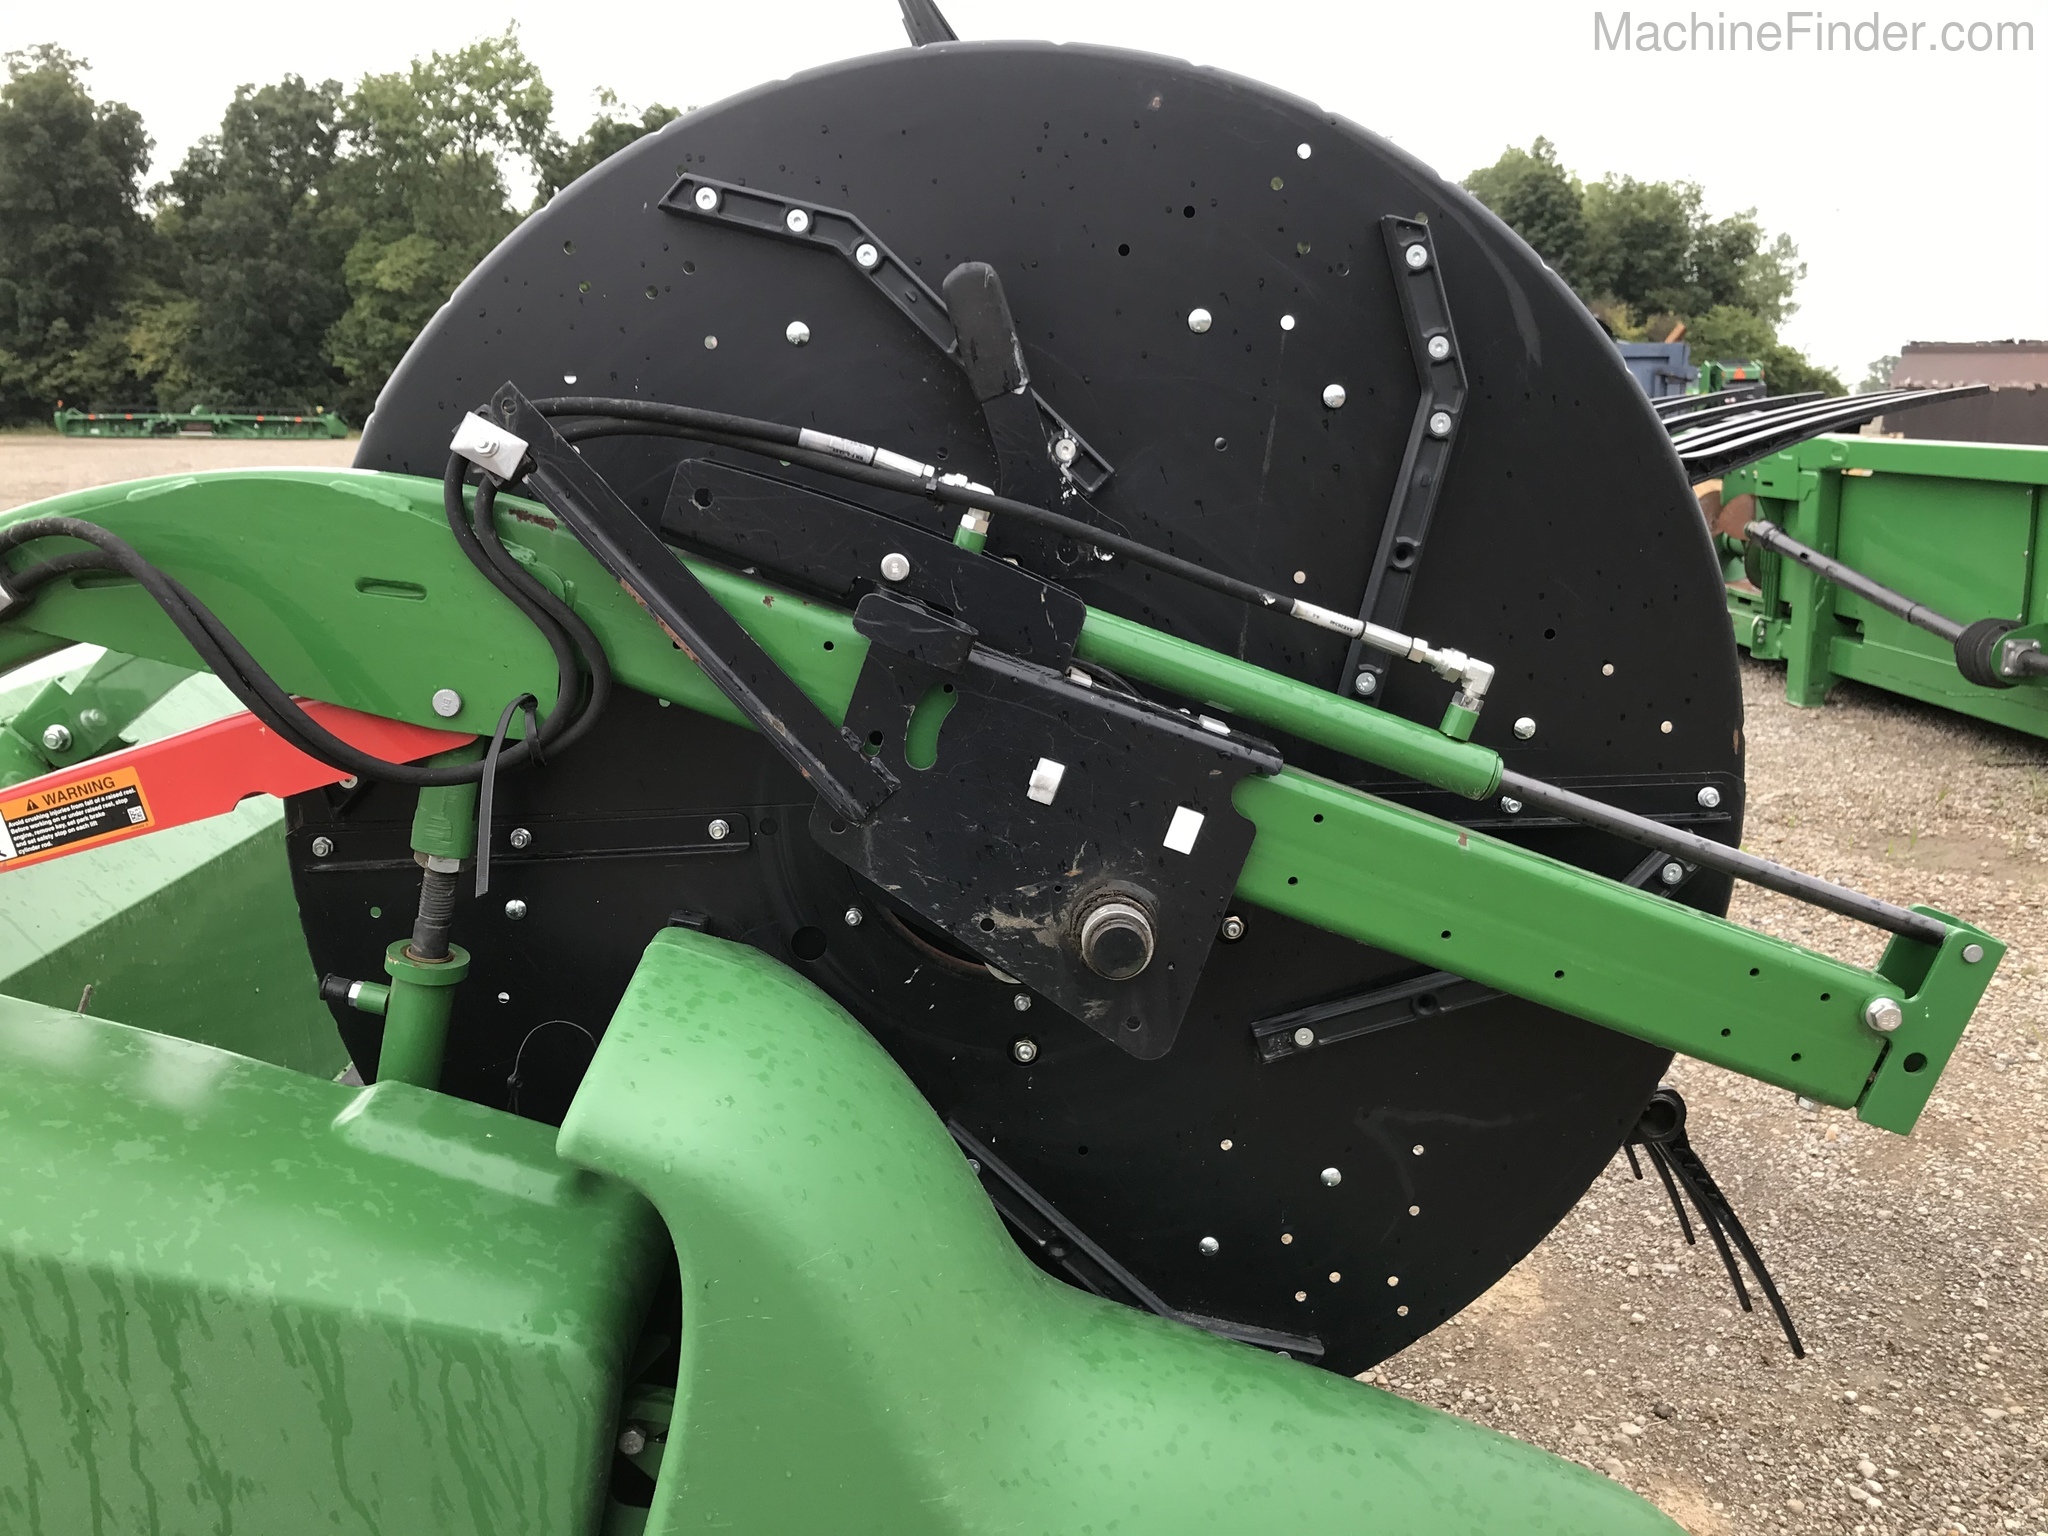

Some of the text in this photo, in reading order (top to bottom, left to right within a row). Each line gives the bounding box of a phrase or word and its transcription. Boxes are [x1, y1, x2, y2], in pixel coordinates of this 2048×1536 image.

[41, 776, 116, 806] WARNING
[8, 819, 24, 828] Avoid
[24, 813, 50, 823] crushing
[49, 807, 70, 816] injuries
[105, 791, 123, 800] raised
[123, 787, 136, 796] reel.
[10, 826, 29, 834] Before
[29, 819, 52, 829] working
[68, 810, 84, 818] under
[84, 804, 102, 814] raised
[115, 797, 128, 806] stop
[16, 840, 27, 848] and
[37, 833, 54, 842] safety
[54, 829, 67, 838] stop
[76, 823, 90, 831] each
[34, 826, 55, 835] remove
[76, 815, 89, 825] park
[89, 811, 106, 820] brake
[18, 844, 40, 855] cylinder
